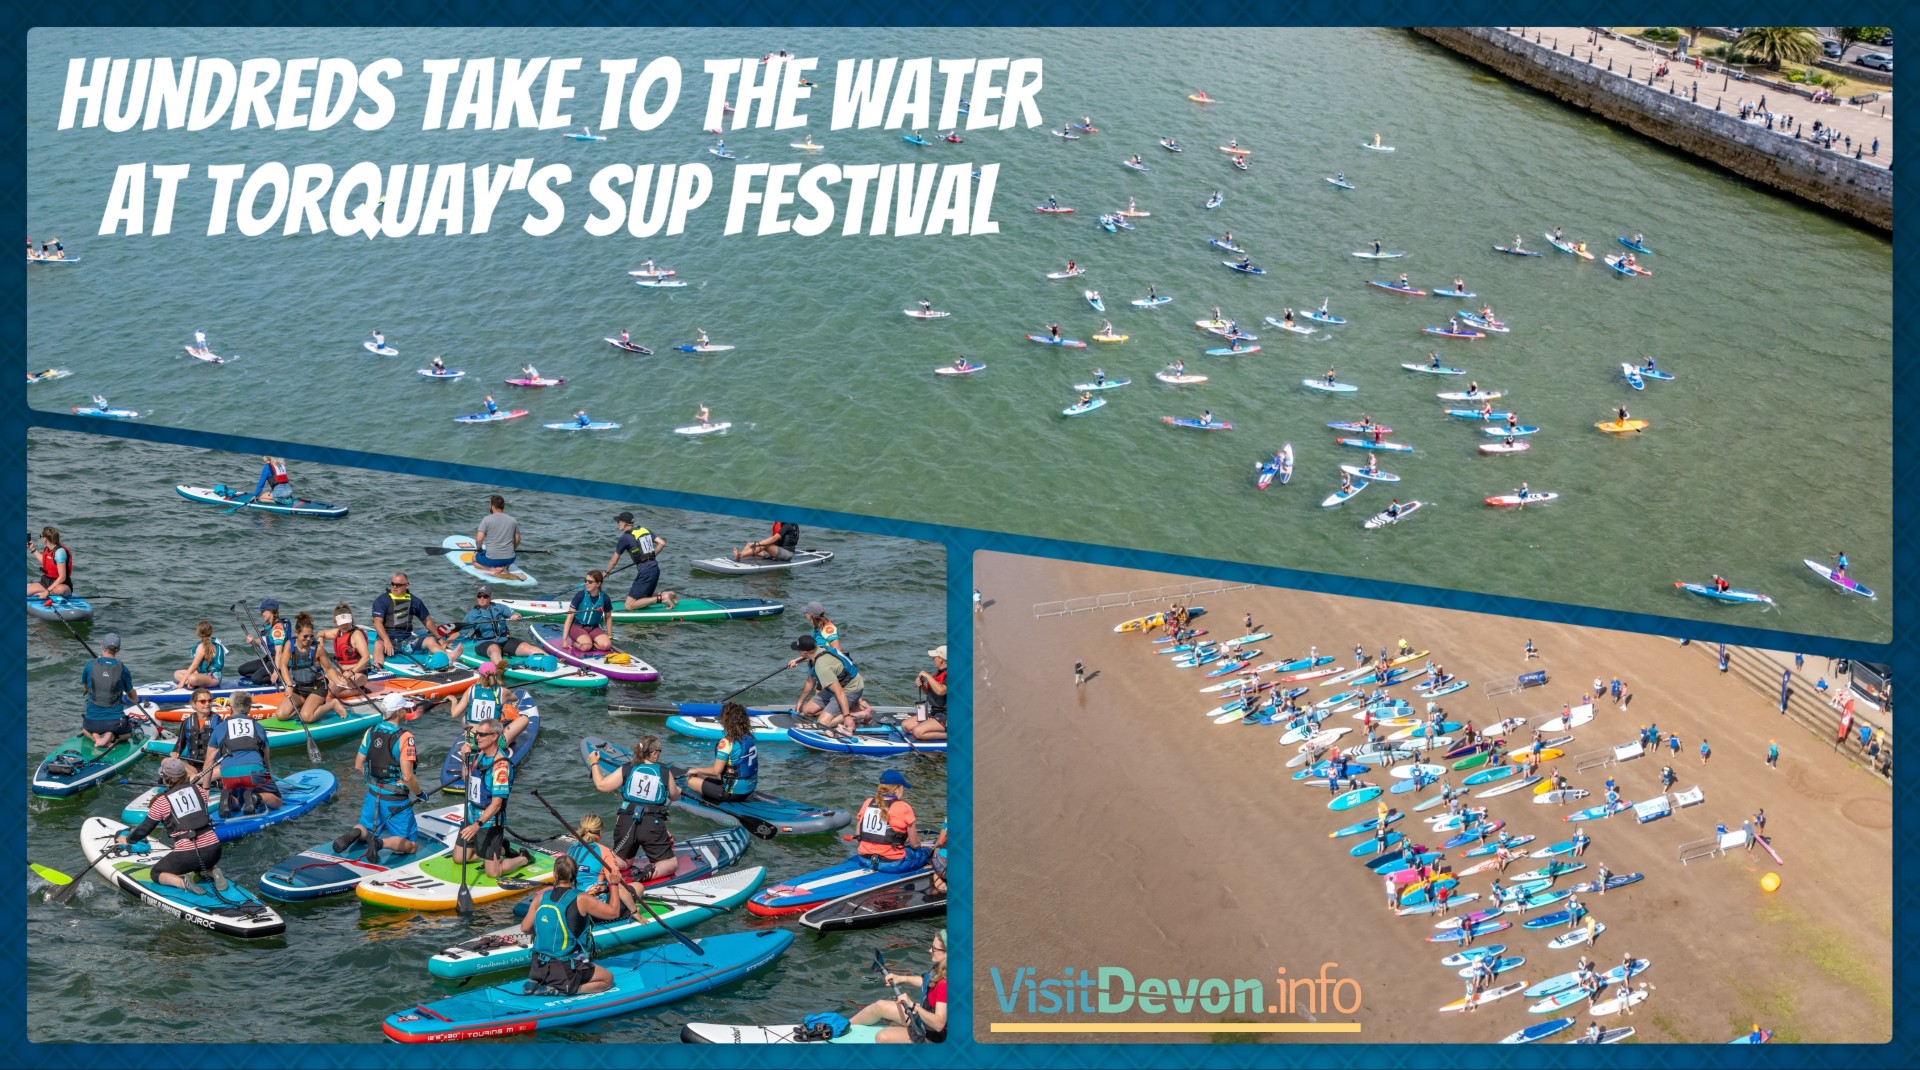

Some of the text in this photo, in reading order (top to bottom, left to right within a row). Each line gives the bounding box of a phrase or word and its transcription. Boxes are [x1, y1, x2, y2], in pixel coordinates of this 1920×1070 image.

[475, 704, 492, 719] 160
[232, 722, 251, 736] 135
[636, 779, 652, 797] 54
[175, 793, 196, 813] 191
[476, 959, 509, 970] Sandbanks
